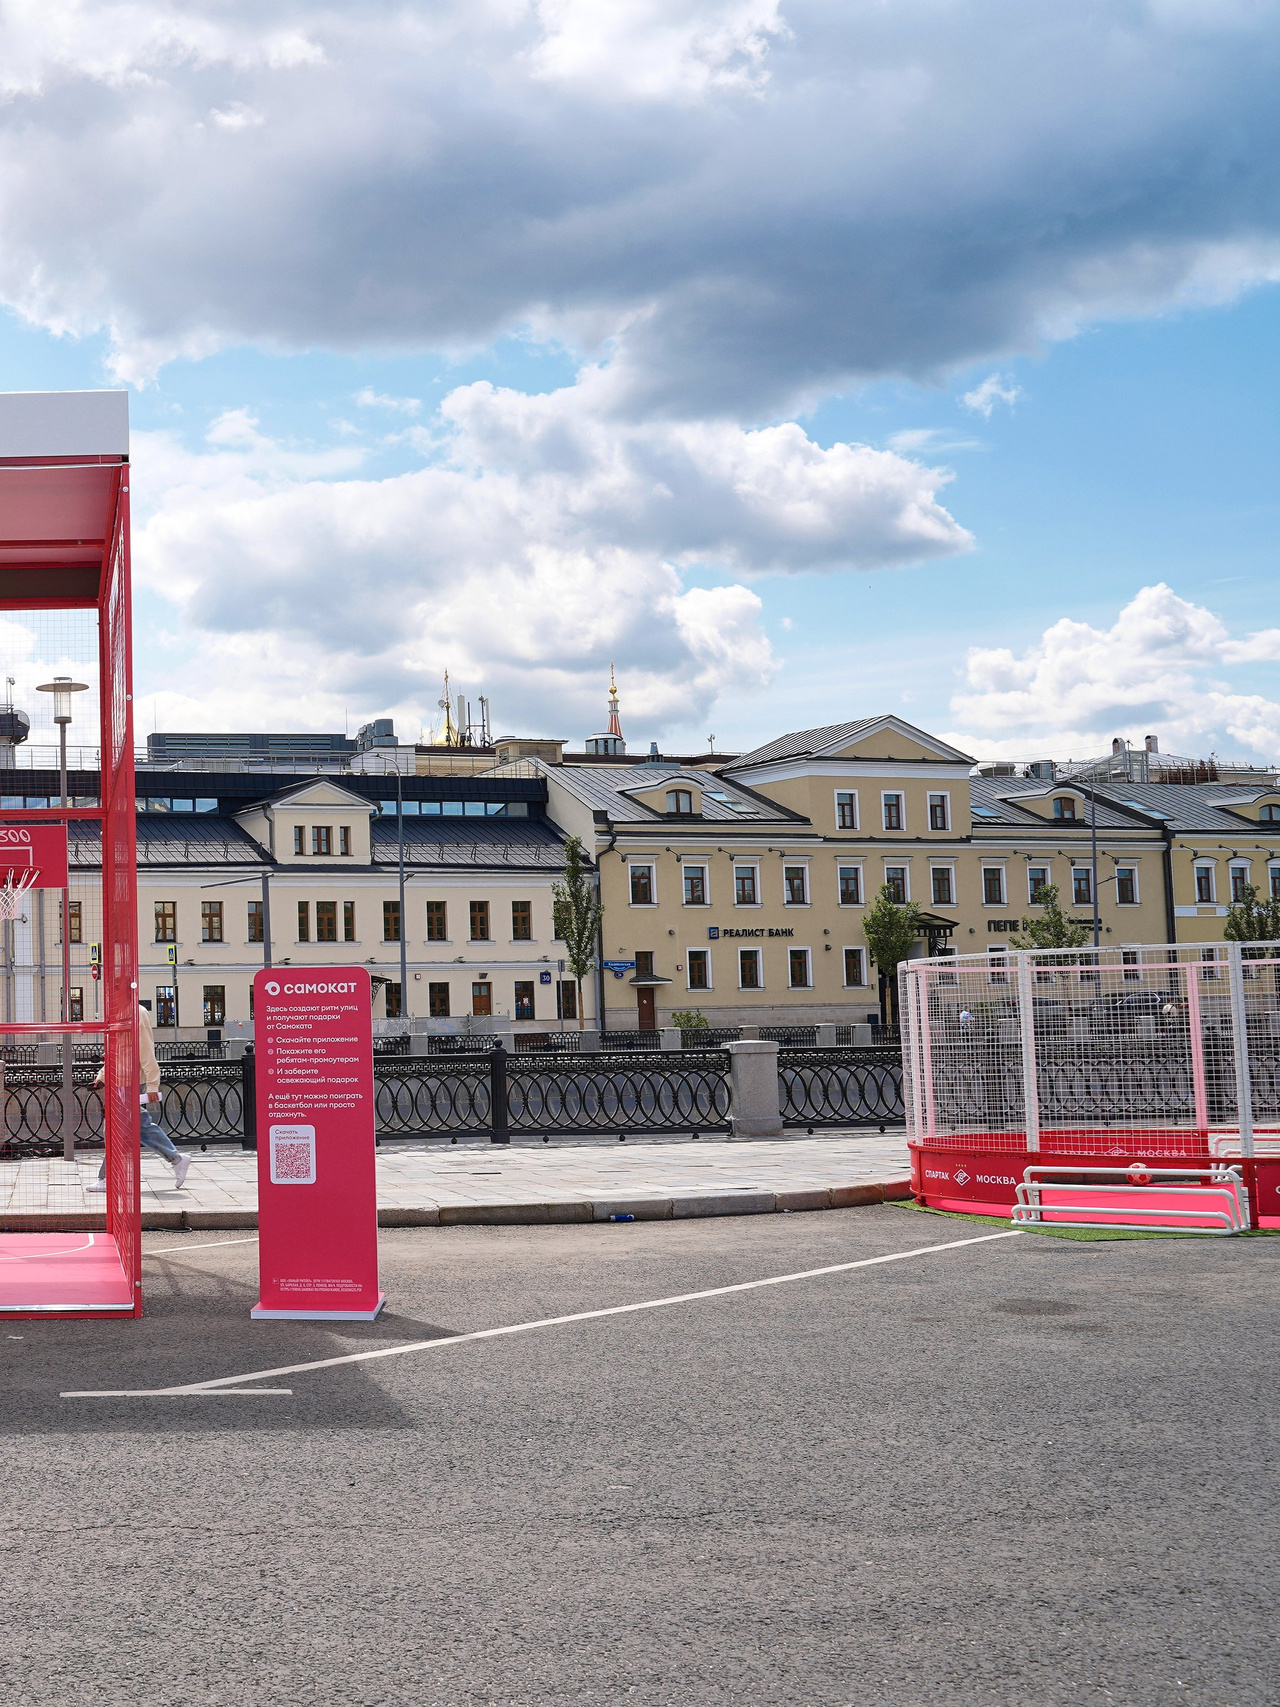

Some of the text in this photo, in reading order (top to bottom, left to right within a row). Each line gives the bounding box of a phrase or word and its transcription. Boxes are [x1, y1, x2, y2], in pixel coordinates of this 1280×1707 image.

[987, 919, 1020, 933] ПЕПЕ
[723, 928, 794, 938] РЕАЛИСТ БАНК
[283, 982, 357, 994] самокат
[925, 1169, 950, 1180] СПАРТАК
[976, 1174, 1017, 1185] МОСКВА
